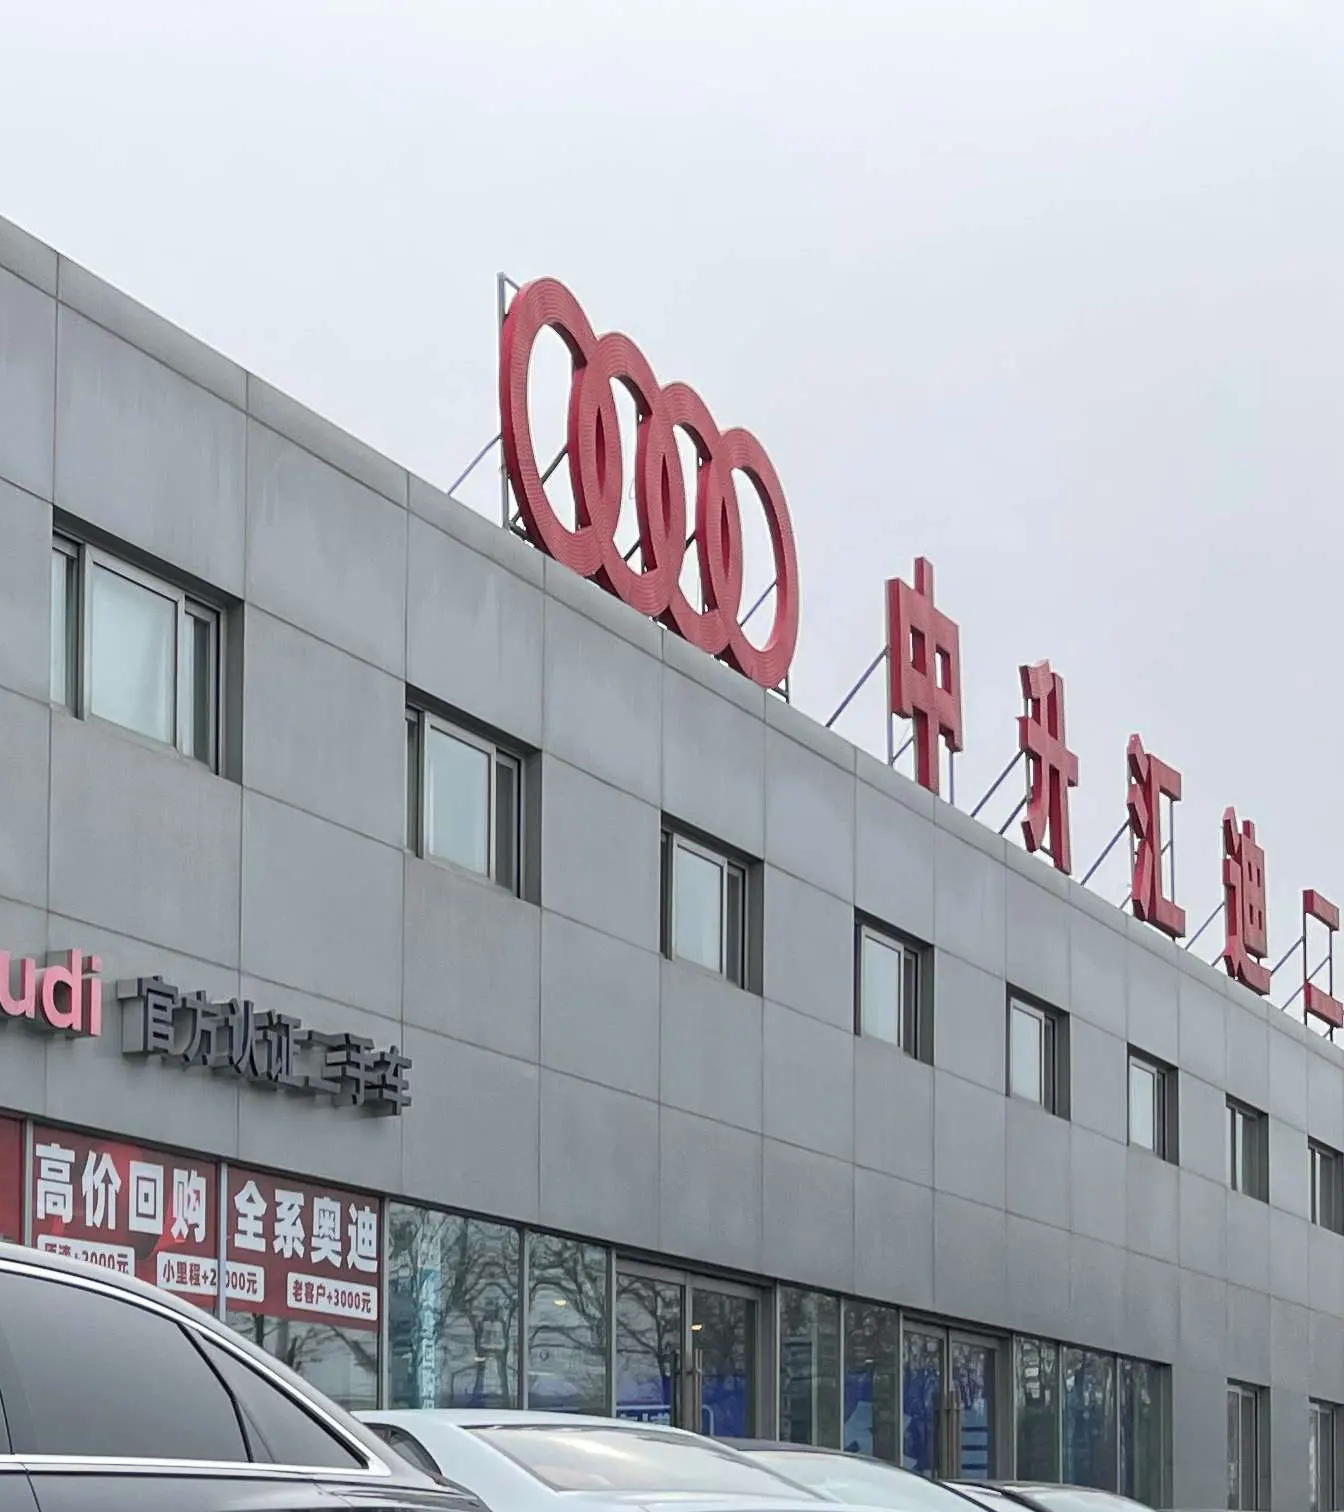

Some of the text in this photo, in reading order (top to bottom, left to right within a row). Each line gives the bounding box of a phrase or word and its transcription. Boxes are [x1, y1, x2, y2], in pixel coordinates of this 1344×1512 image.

[118, 975, 412, 1116] 官方认证二手车
[35, 1142, 207, 1243] 高价回购
[233, 1179, 378, 1273] 全系奥迪
[292, 1278, 372, 1313] 老客户+3000元
